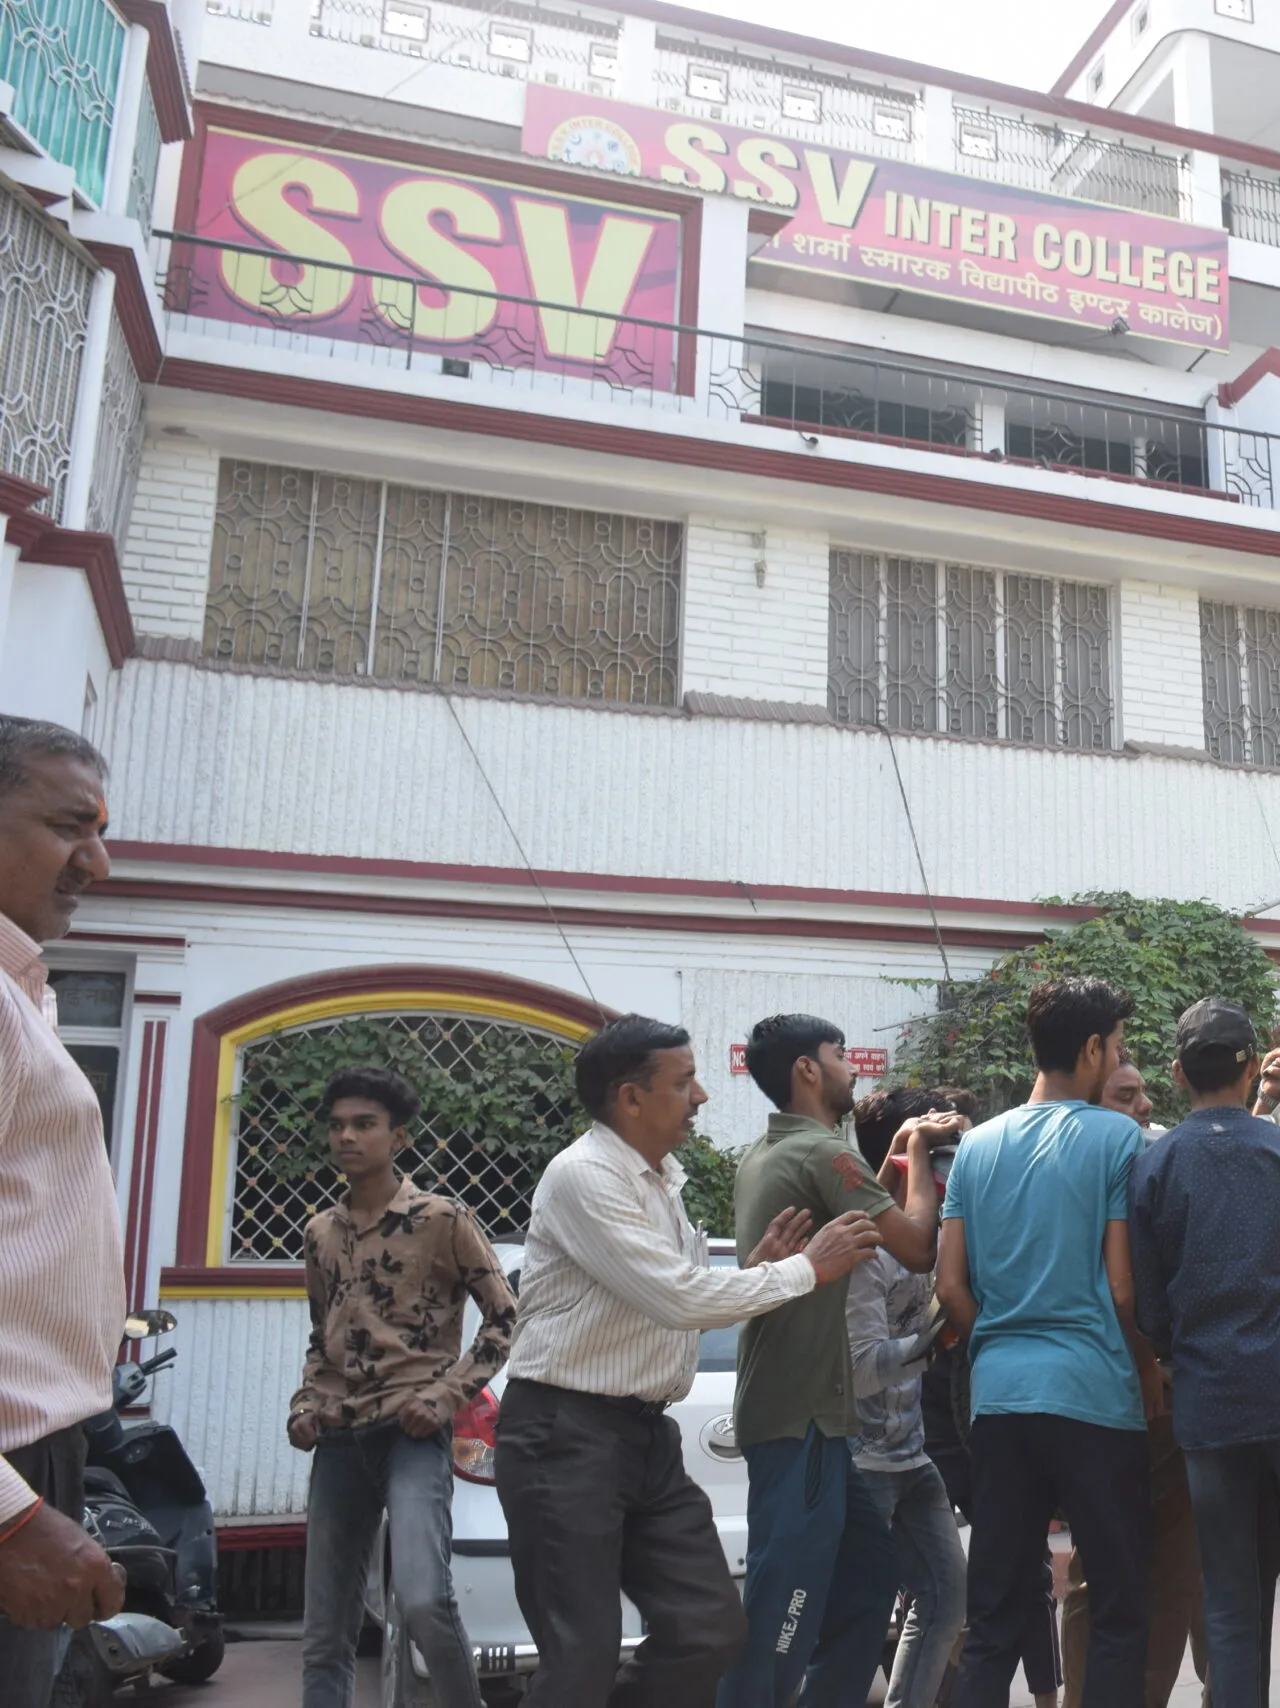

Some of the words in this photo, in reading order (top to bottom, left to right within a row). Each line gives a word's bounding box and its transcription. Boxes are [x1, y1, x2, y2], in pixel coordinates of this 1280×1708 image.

[219, 152, 656, 363] SSV
[660, 122, 877, 228] SSV
[884, 191, 1017, 263] INTER
[1032, 223, 1221, 303] COLLEGE
[793, 232, 852, 264] शर्मा
[859, 244, 951, 283] स्मारक
[958, 257, 1059, 305] विद्यापीठ
